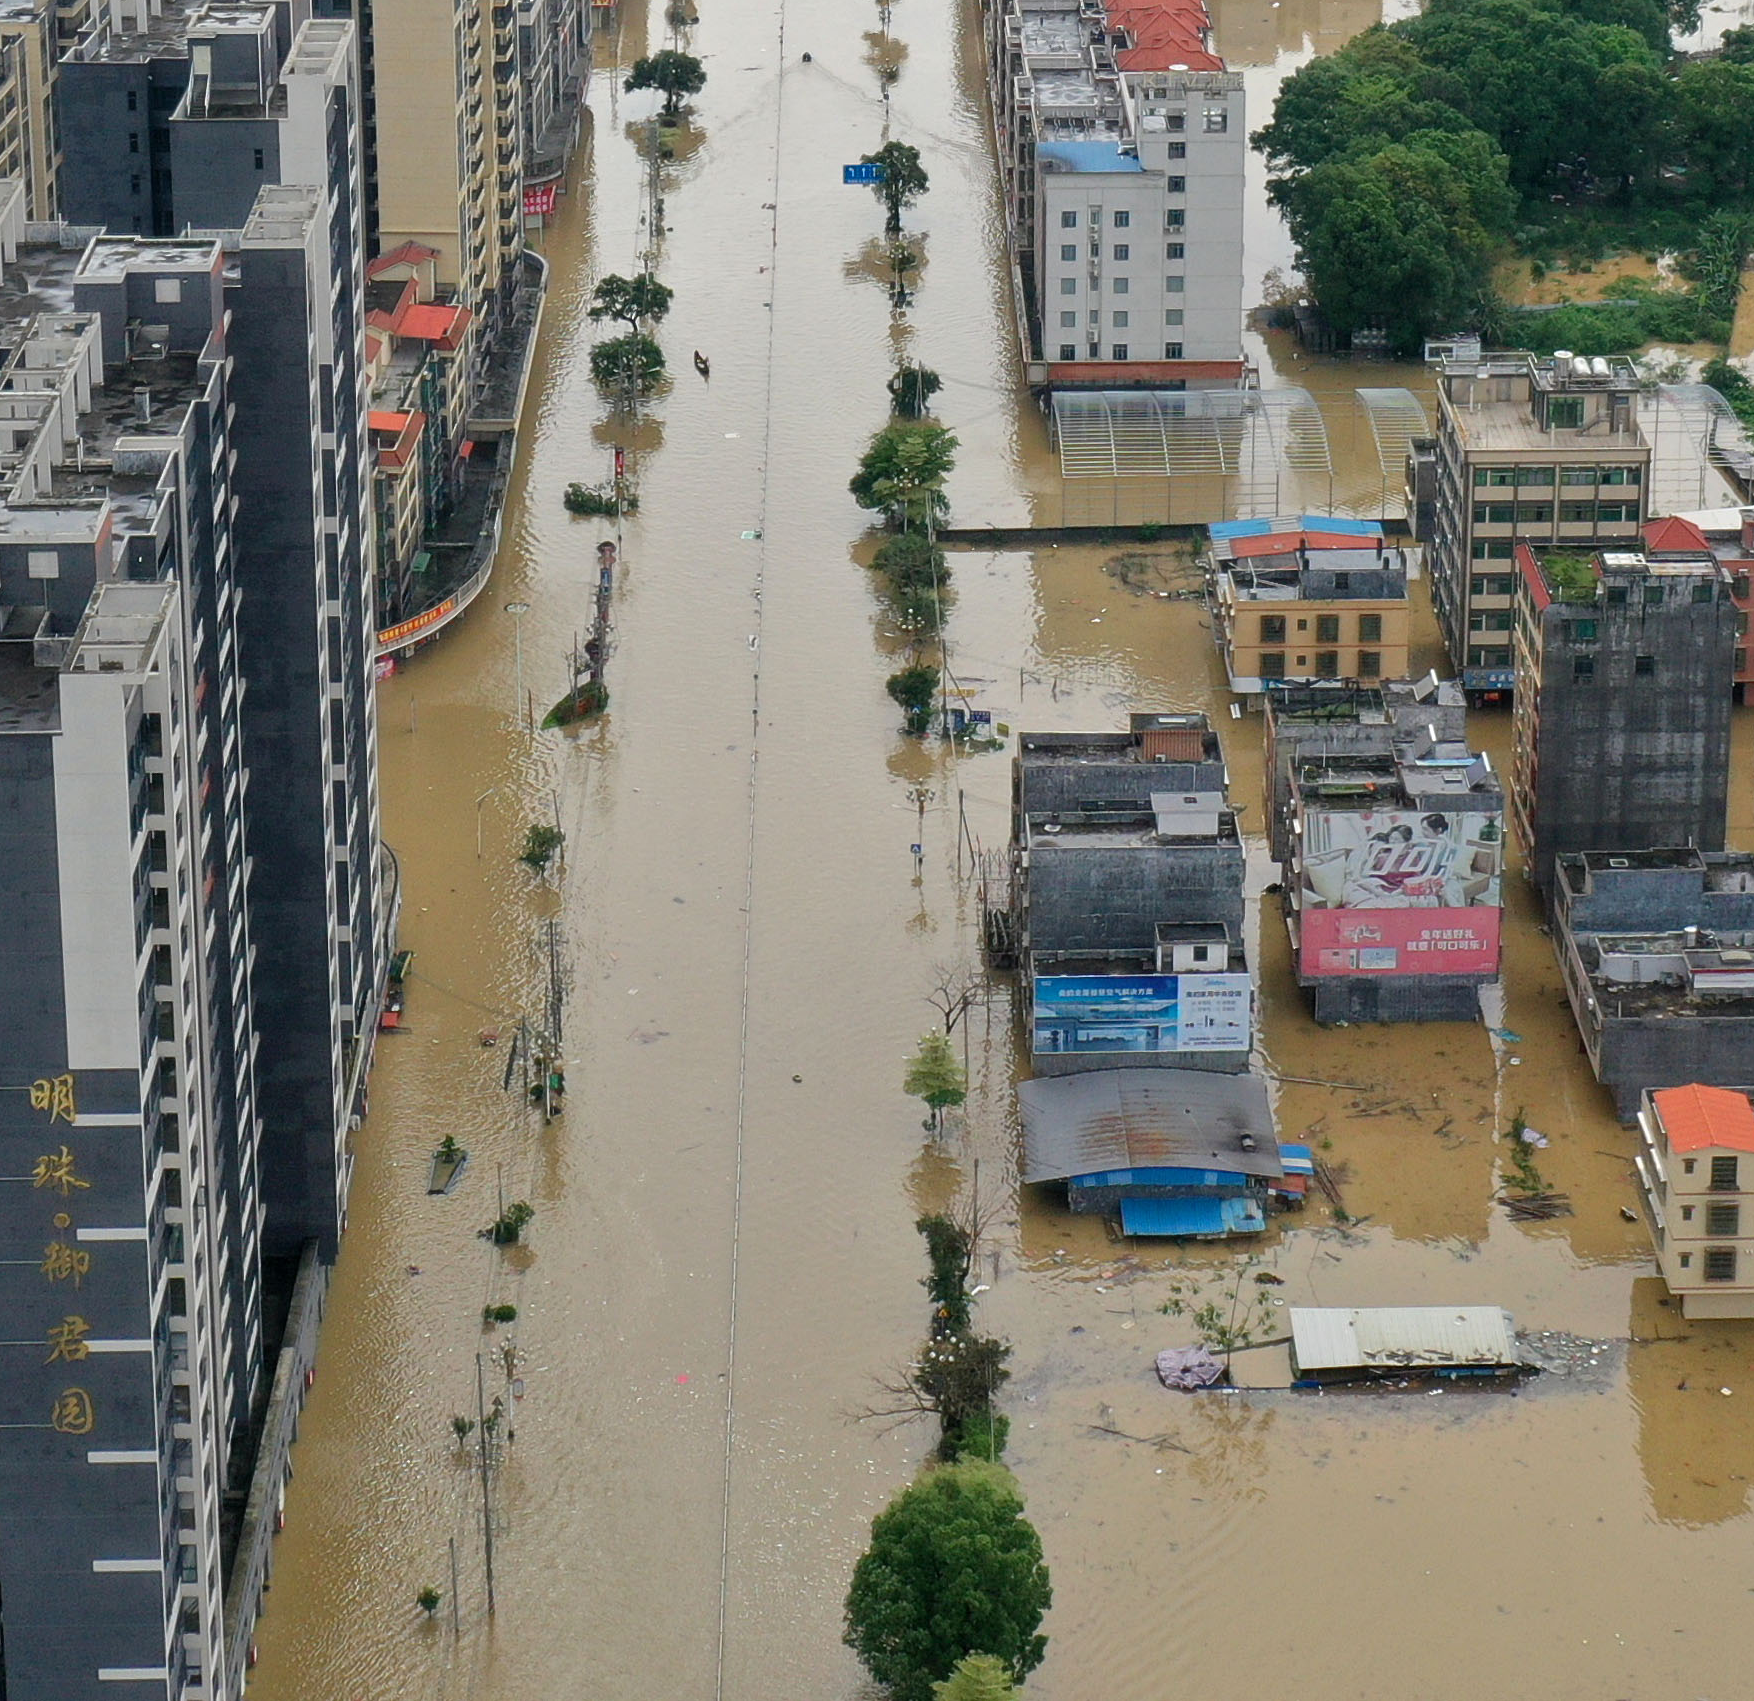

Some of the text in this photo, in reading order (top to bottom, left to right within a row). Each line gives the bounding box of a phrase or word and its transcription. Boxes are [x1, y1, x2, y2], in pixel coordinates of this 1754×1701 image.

[1420, 929, 1475, 940] 兔年送好礼
